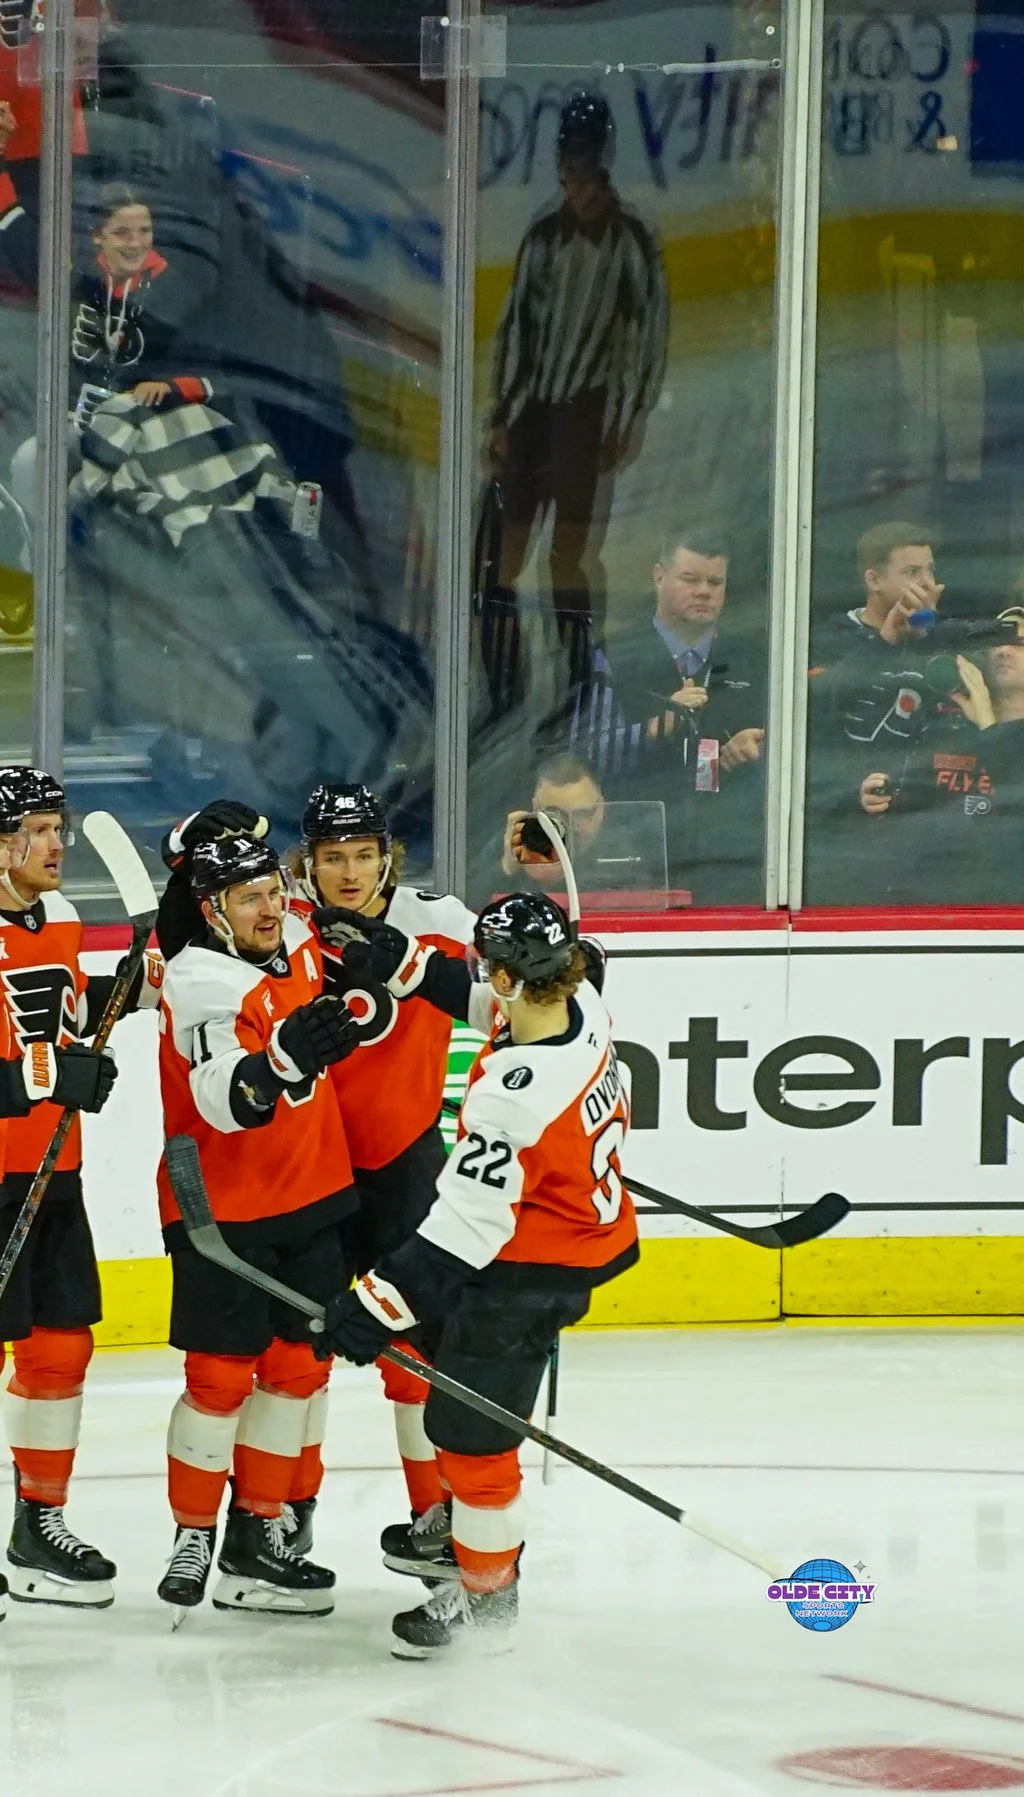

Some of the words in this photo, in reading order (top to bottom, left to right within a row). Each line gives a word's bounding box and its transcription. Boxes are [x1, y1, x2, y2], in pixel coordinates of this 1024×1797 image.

[335, 797, 356, 809] 46
[544, 923, 565, 946] 22
[302, 948, 319, 982] A
[456, 1131, 513, 1190] 22
